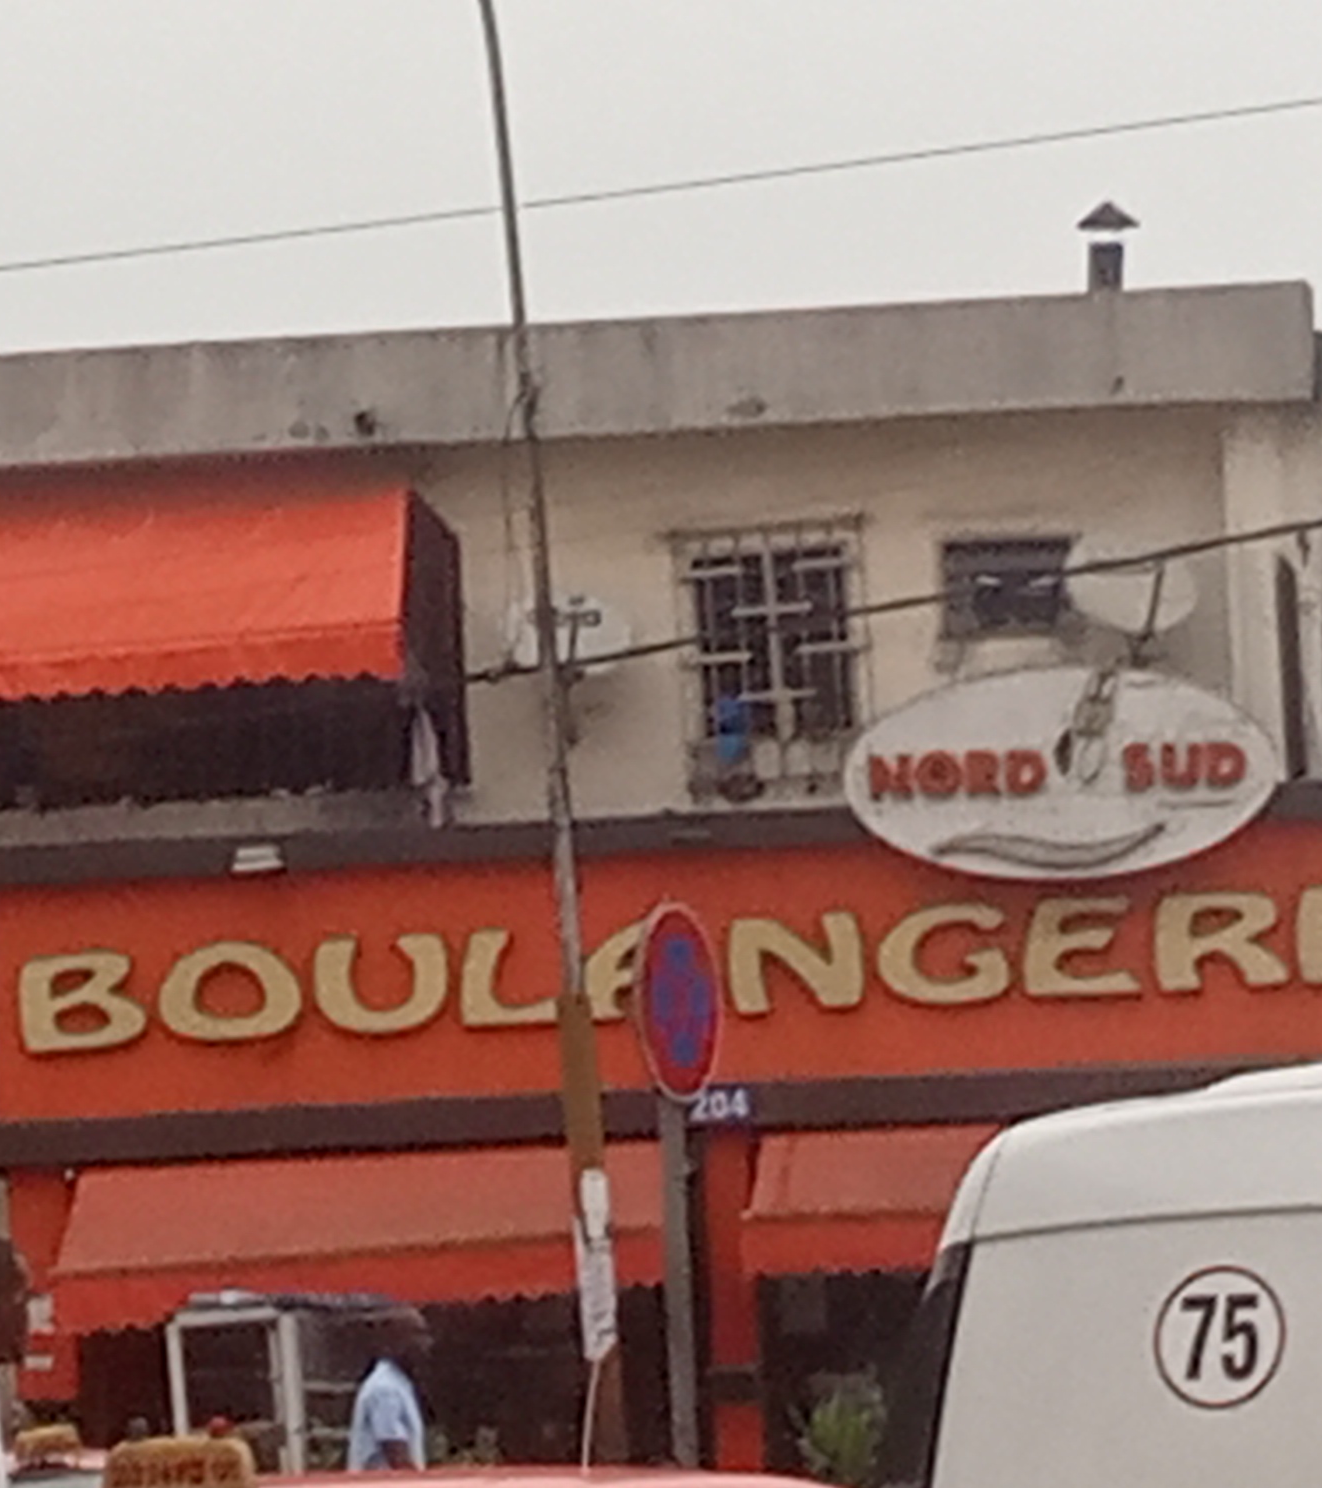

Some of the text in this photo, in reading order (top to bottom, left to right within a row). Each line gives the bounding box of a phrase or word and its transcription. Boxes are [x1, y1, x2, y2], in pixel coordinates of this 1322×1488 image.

[867, 741, 1247, 799] NORD SUD
[689, 1088, 750, 1122] 204
[1180, 1294, 1259, 1381] 75
